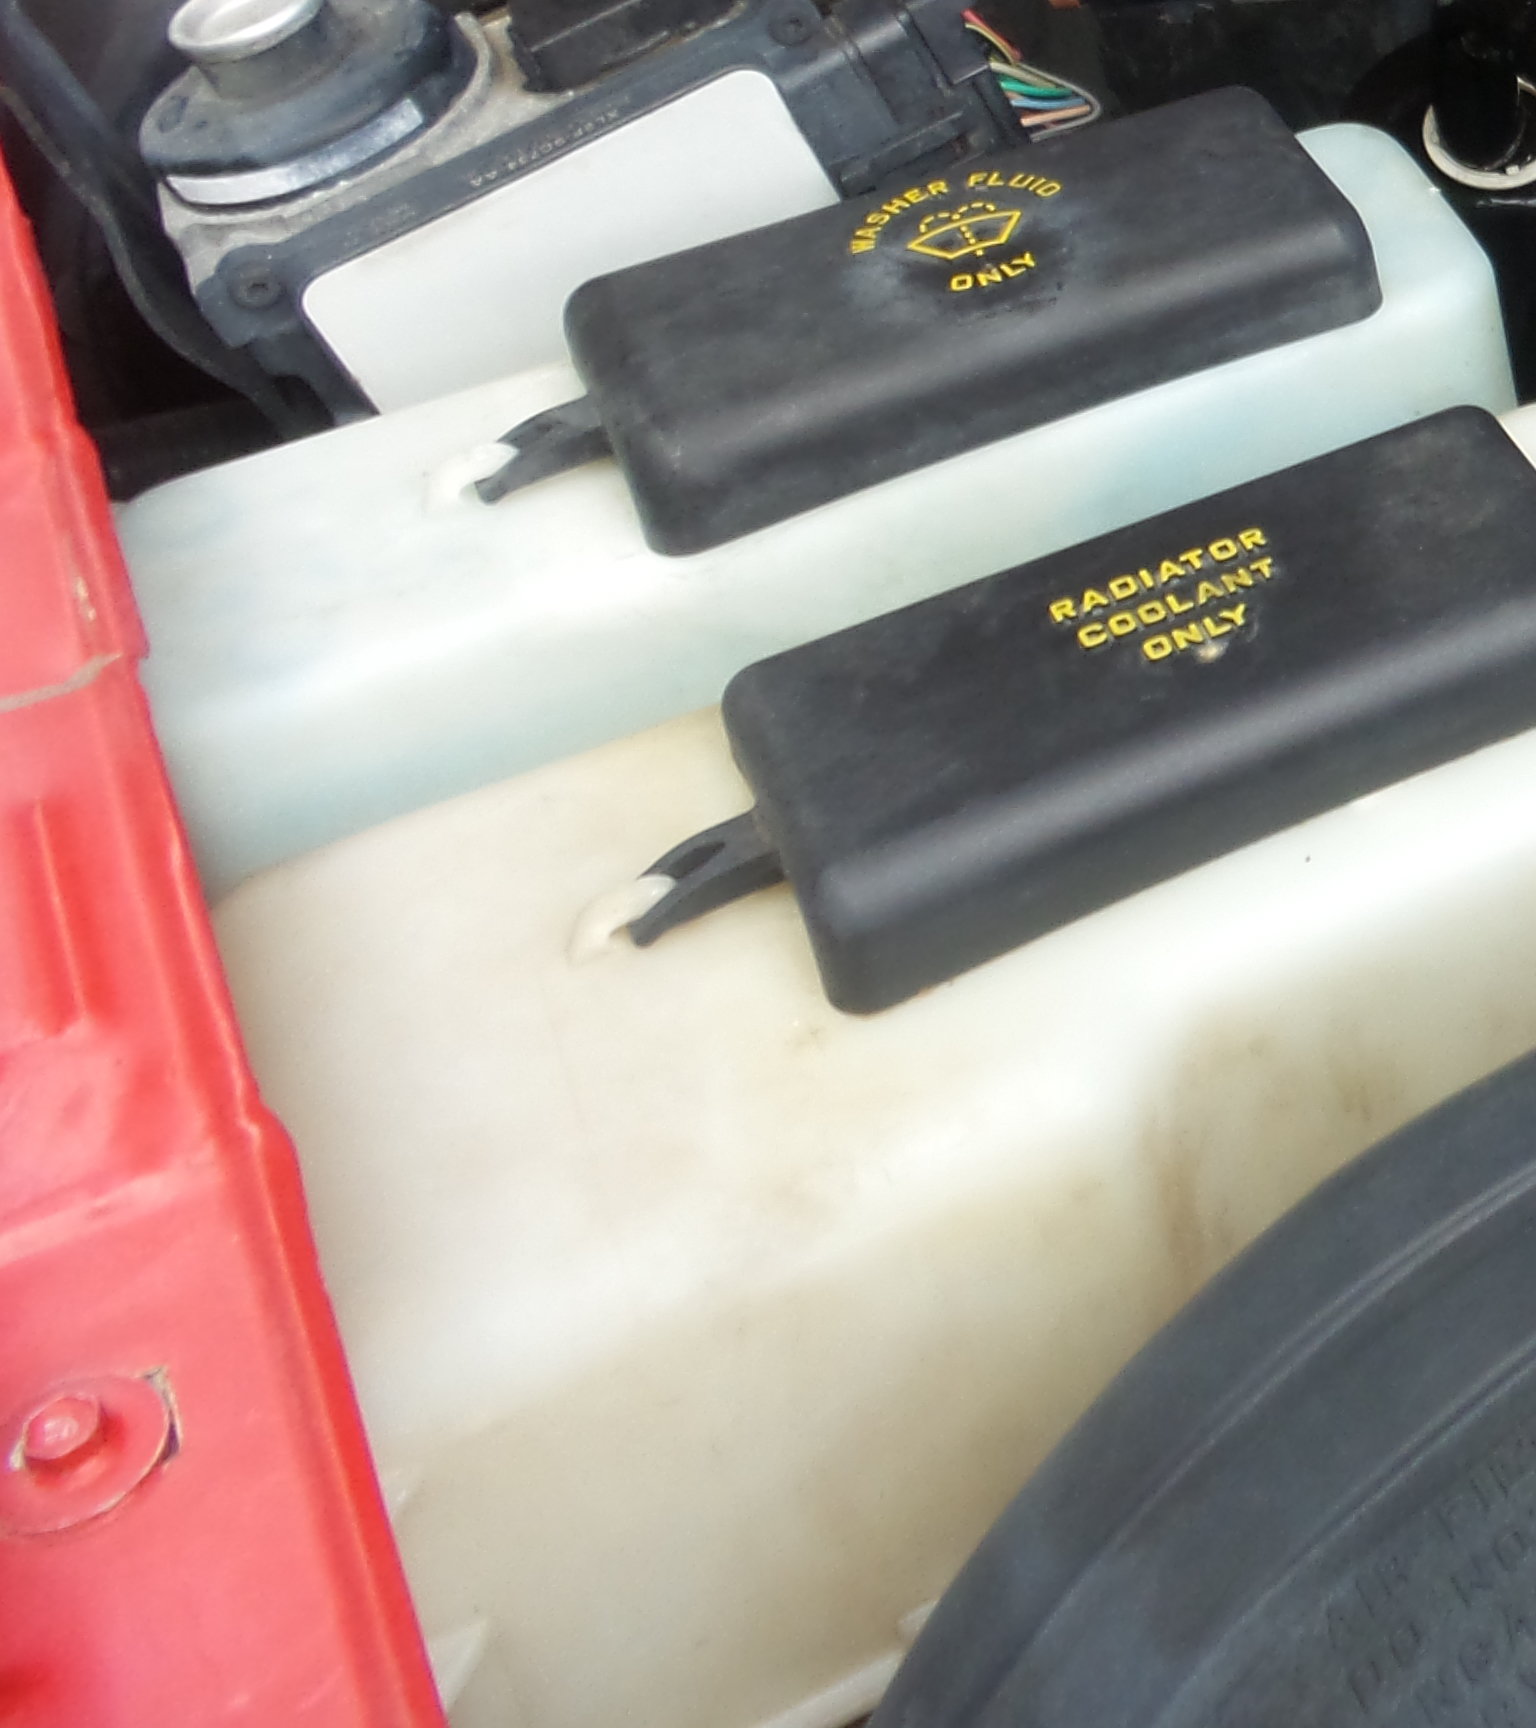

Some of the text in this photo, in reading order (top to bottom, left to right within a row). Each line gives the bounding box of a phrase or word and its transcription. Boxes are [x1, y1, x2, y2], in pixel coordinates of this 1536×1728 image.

[849, 170, 1062, 256] WASHER FLUID
[950, 250, 1039, 294] ONLY
[1048, 526, 1267, 624] RADIATOR
[1076, 556, 1276, 652] COOLANT
[1142, 603, 1248, 665] ONLY
